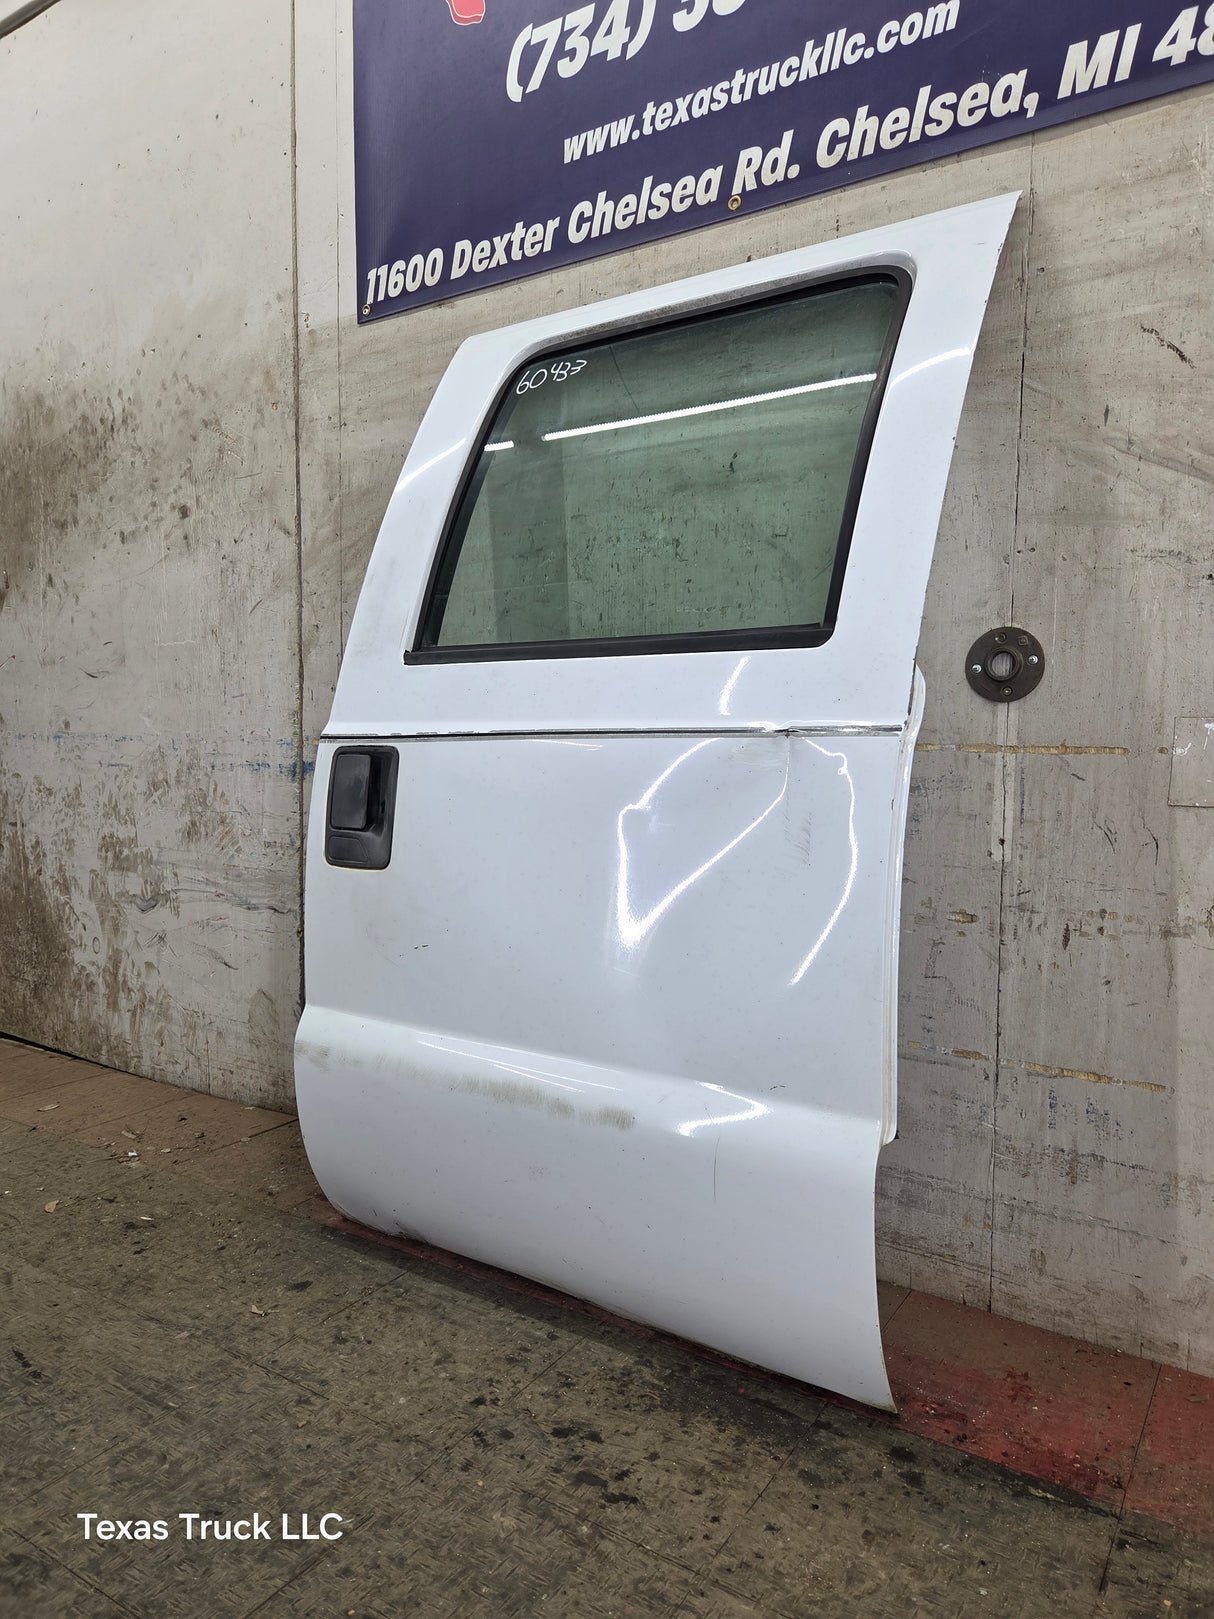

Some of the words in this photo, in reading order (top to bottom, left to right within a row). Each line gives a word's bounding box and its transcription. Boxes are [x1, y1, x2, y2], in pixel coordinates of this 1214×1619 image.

[506, 0, 656, 103] (734)
[563, 0, 960, 164] www.texastruckllc.com
[366, 247, 444, 305] 11600
[450, 214, 560, 280] Dexter
[567, 164, 724, 245] Chelsea
[731, 130, 800, 197] Rd.
[816, 68, 1040, 169] Chelsea,
[1056, 23, 1143, 100] MI
